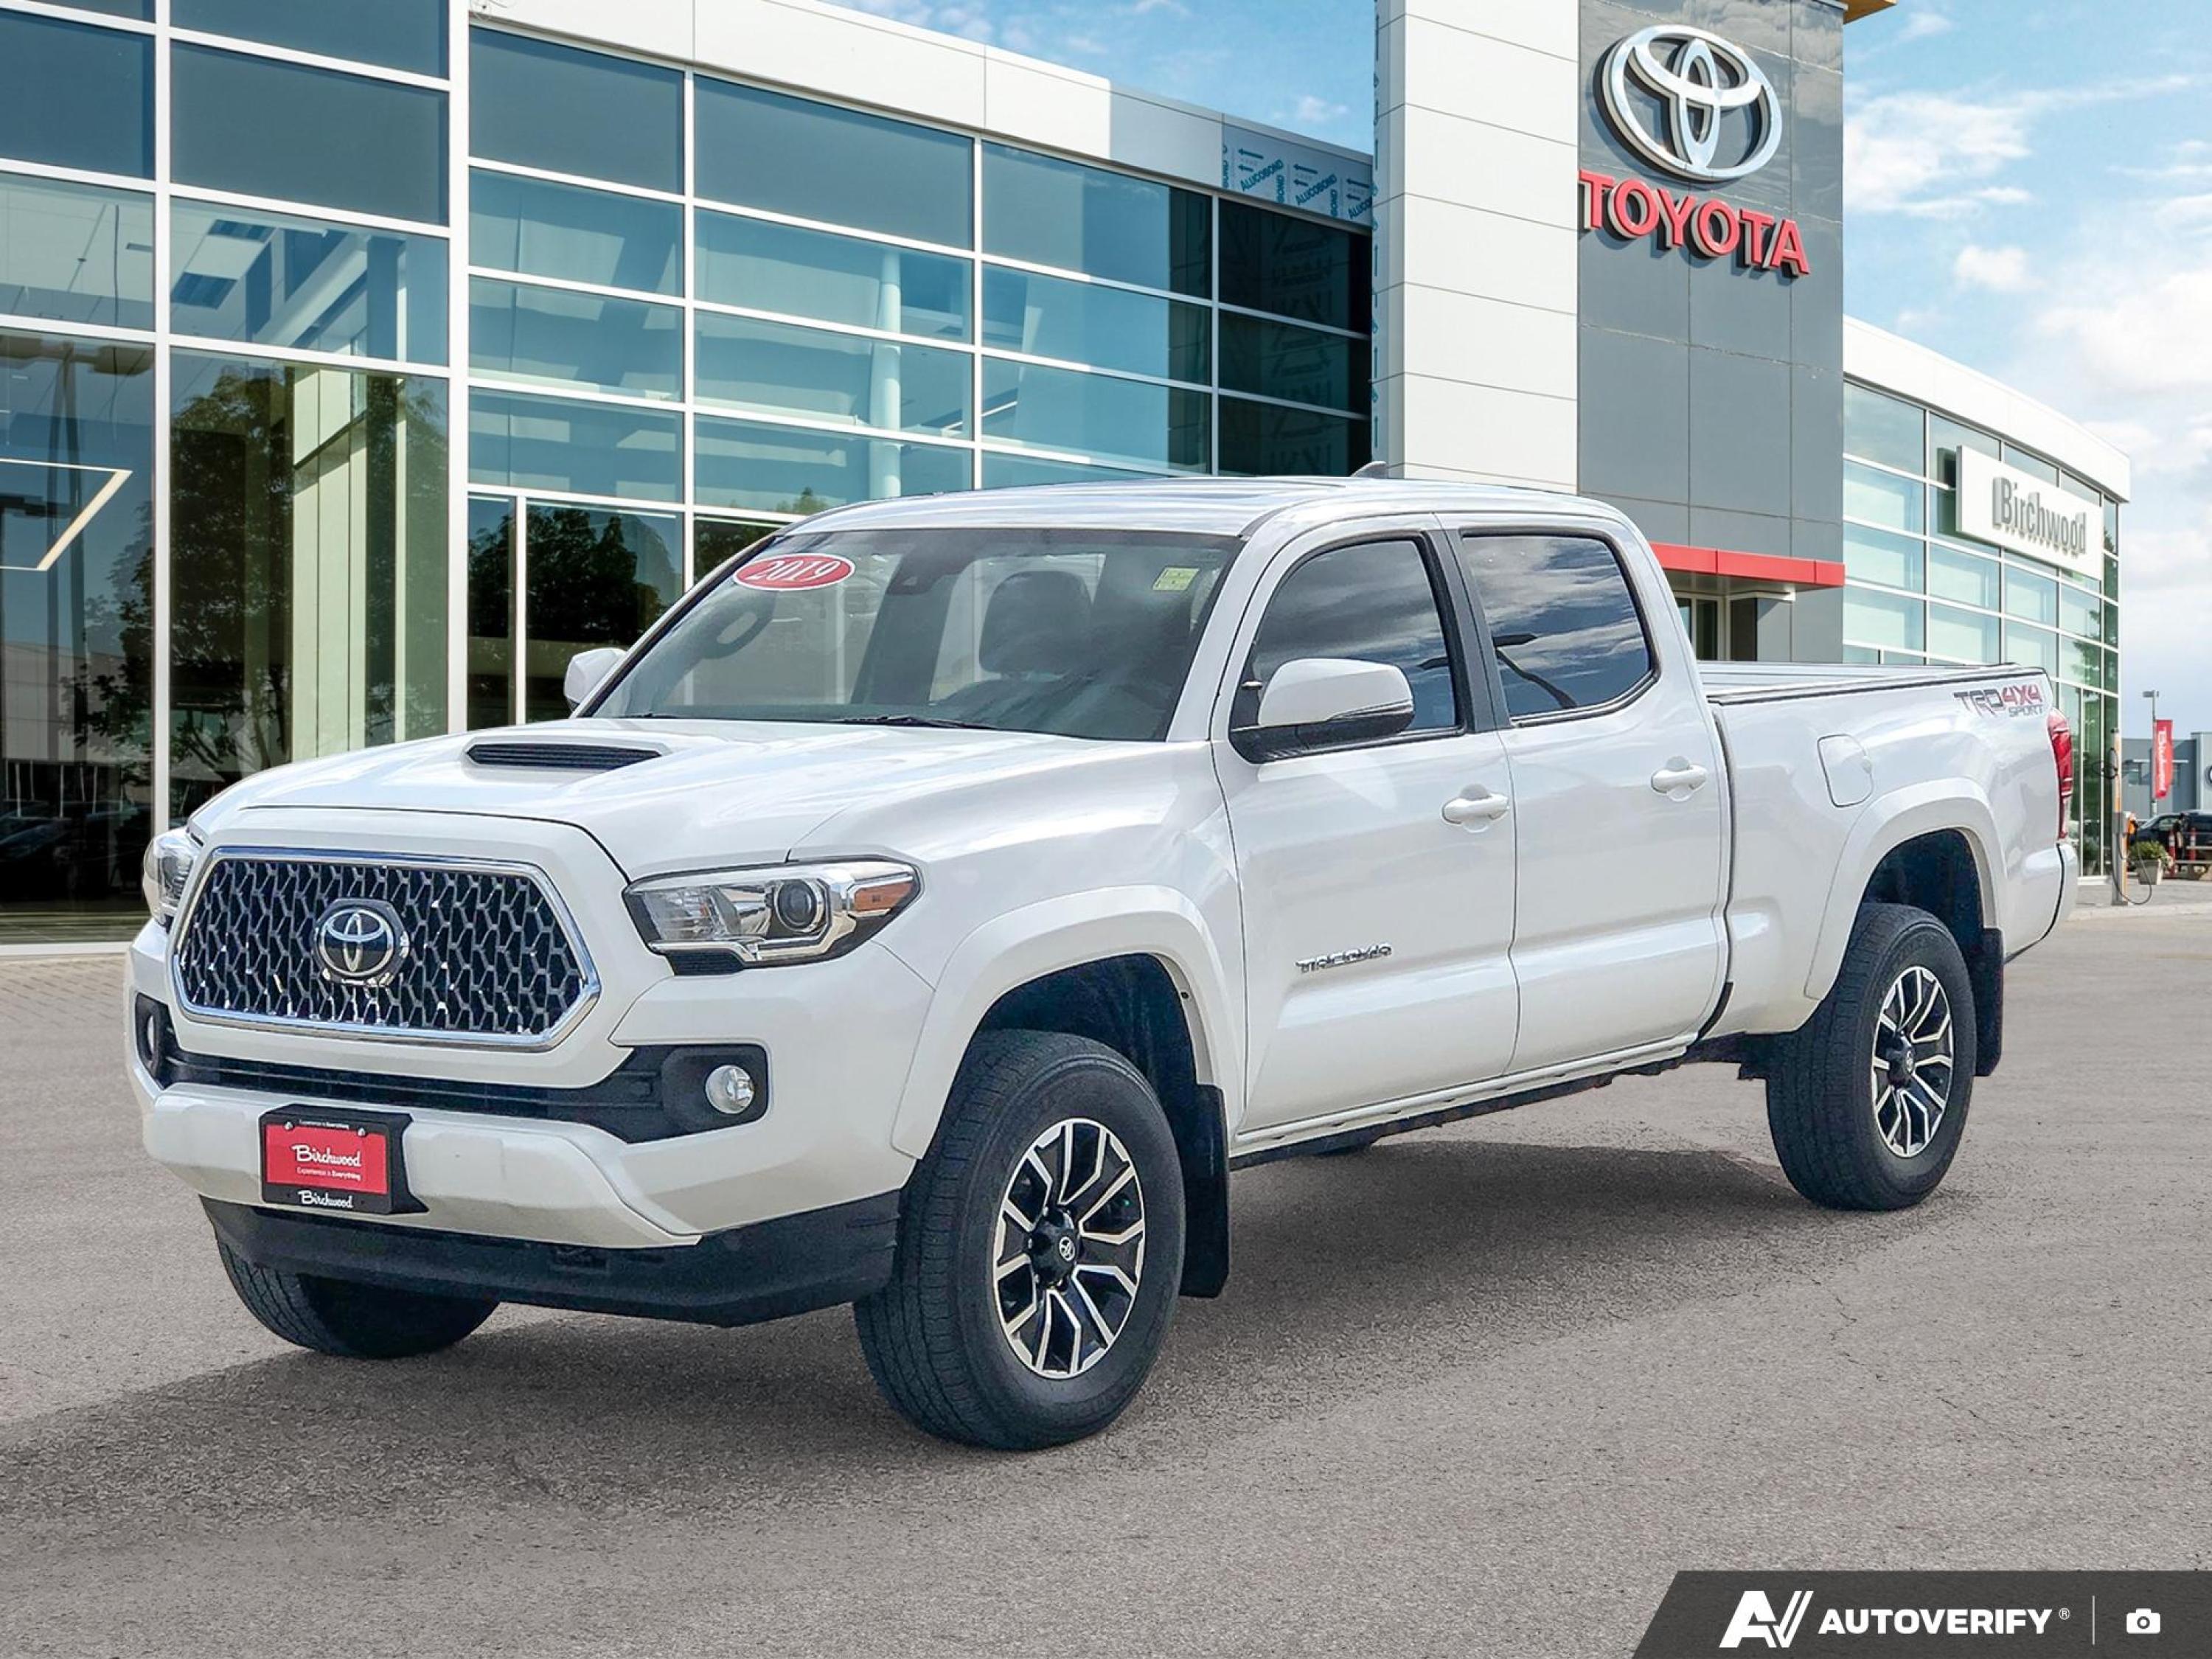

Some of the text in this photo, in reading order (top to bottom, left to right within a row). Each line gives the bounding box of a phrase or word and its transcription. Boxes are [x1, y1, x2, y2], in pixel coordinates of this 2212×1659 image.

[1241, 159, 1283, 191] ALUCOBOND
[1296, 174, 1337, 205] ALUCOBOND
[1579, 169, 1810, 275] TOYOTA
[1994, 477, 2086, 557] Birchwood
[745, 560, 841, 582] 2019
[1952, 689, 2004, 717] TRD
[2008, 704, 2044, 717] SPORT
[1295, 942, 1392, 973] TACOMA
[291, 1144, 361, 1166] Birchwood
[298, 1189, 354, 1208] Birchwood
